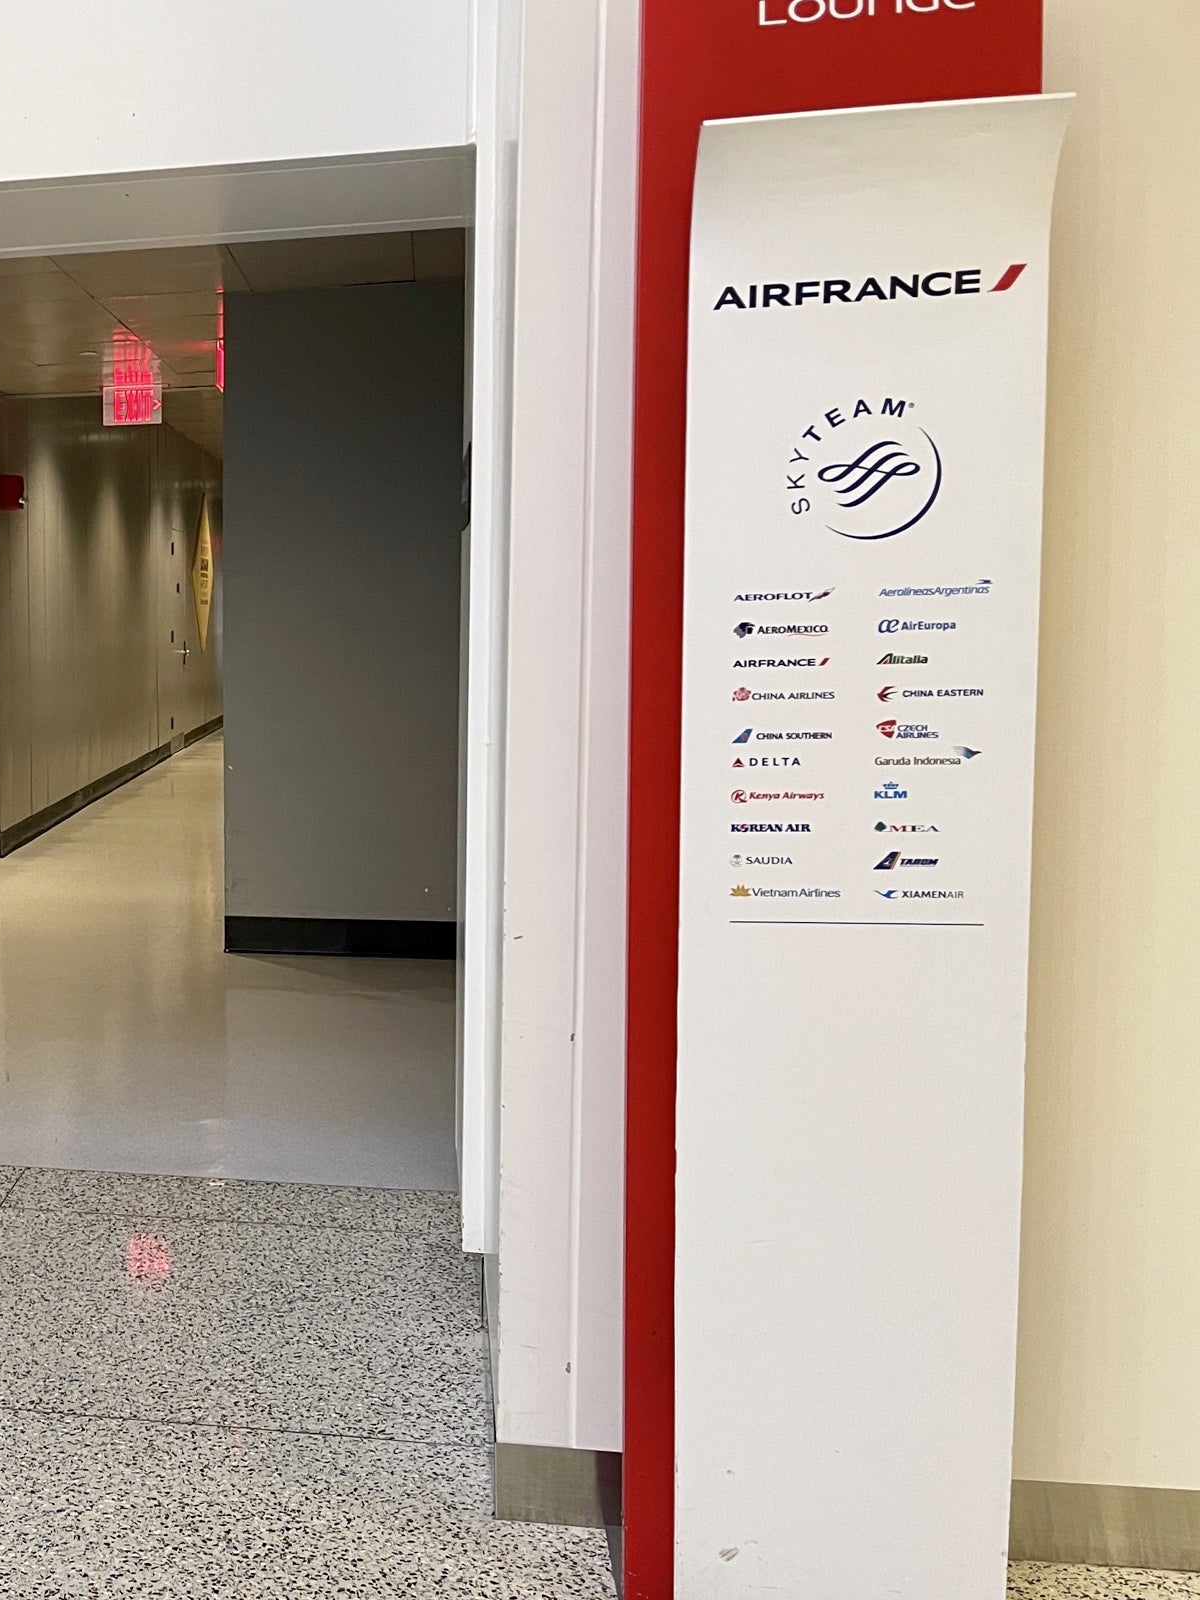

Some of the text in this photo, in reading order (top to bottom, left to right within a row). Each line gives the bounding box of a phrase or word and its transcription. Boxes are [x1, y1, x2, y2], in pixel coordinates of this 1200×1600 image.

[713, 269, 981, 310] AIRFRANCE
[114, 389, 154, 423] EXIT
[733, 591, 813, 602] AEROFLOT
[901, 621, 956, 632] AirEuropa
[733, 658, 817, 668] AIRFRANCE
[876, 653, 928, 665] Alitalia
[752, 690, 835, 701] CHINA AIRLINES
[902, 688, 984, 698] CHINA EASTERN
[897, 724, 928, 732] CZECH
[756, 731, 832, 740] CHINA SOUTHERN
[896, 731, 939, 739] AIRLINES
[749, 757, 801, 767] DELTA
[874, 756, 961, 766] Garuda Indonesia
[749, 791, 780, 801] Kenya
[782, 791, 825, 801] Airways
[873, 790, 908, 799] KLM
[730, 824, 811, 833] KOREAN AIR
[886, 824, 940, 833] MEA
[746, 856, 793, 865] SAUDIA
[752, 888, 841, 898] Vietnam Airlines
[901, 890, 965, 899] XIAMENAIR
